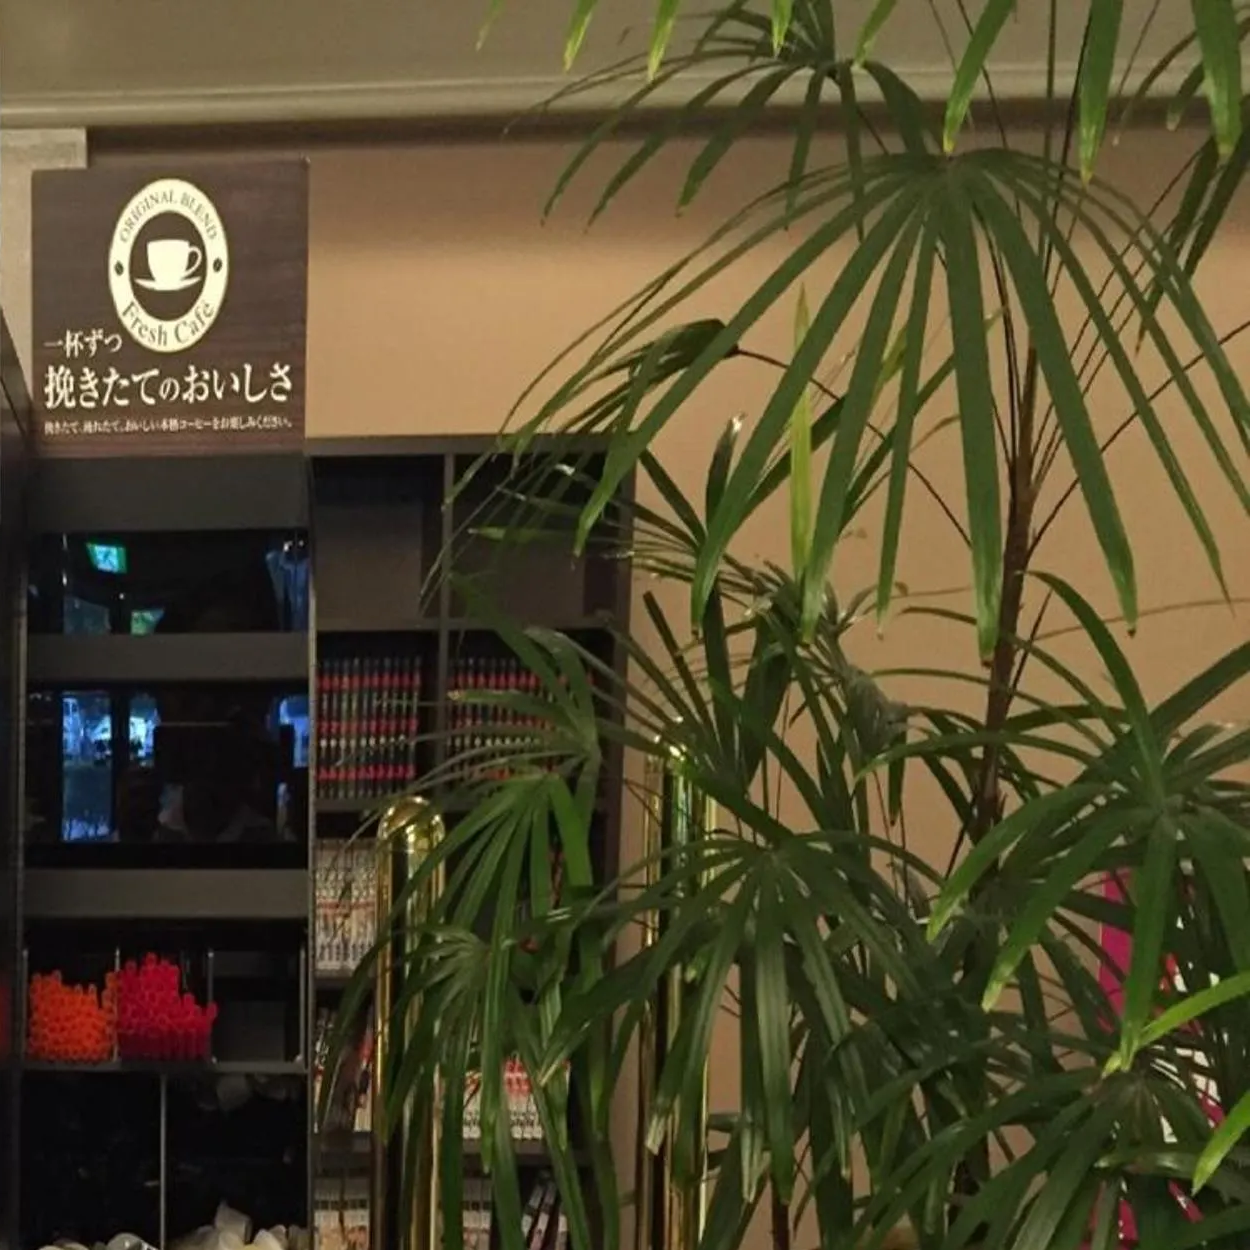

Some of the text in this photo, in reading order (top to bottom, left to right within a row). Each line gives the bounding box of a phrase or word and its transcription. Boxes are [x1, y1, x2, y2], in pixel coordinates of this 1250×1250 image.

[119, 188, 218, 242] ORIGINAL BLEND
[44, 328, 123, 358] 一杯ずつ
[121, 301, 168, 347] Fresh
[43, 362, 293, 409] 挽きたてのおいしさ
